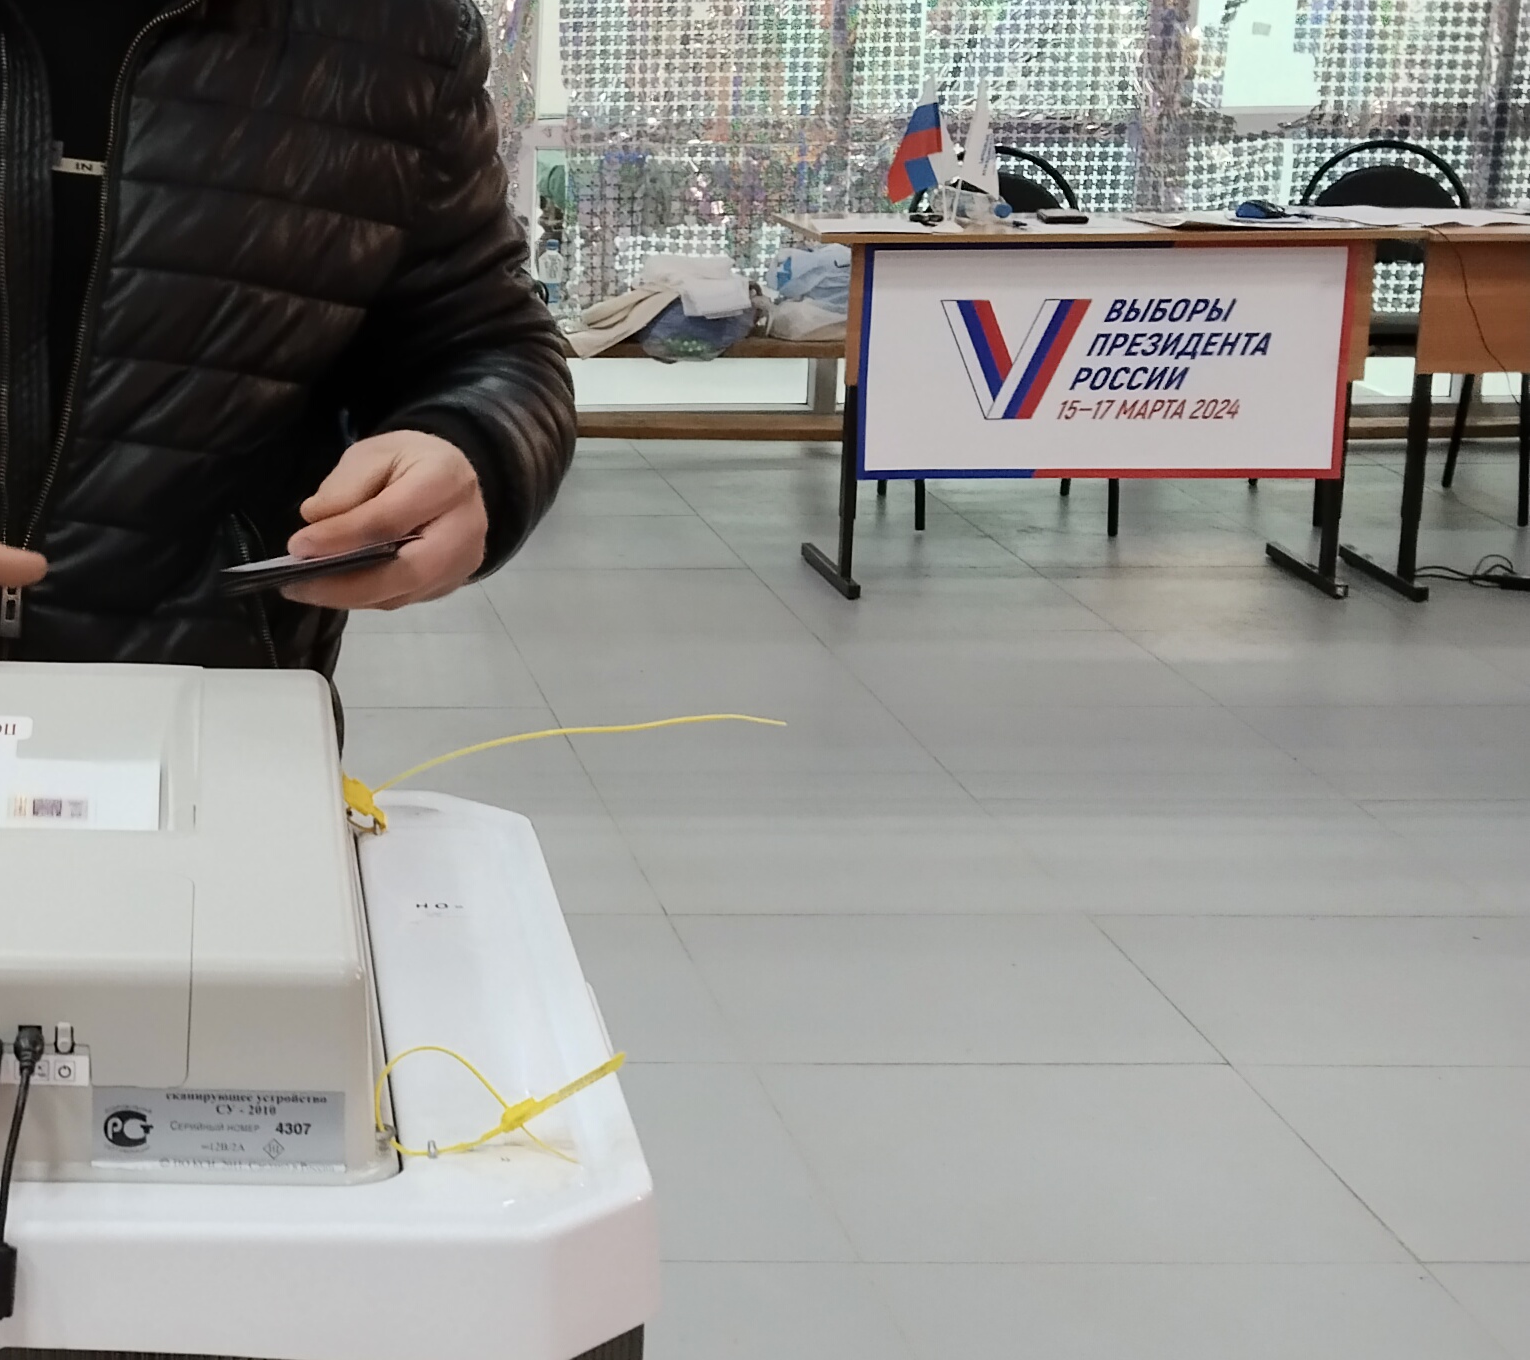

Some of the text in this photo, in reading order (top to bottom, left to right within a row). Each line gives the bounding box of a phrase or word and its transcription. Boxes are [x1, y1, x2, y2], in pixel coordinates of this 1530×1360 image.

[1104, 298, 1238, 323] ВЫБОРЫ
[1086, 331, 1272, 360] ПРЕЗИДЕНТА
[1068, 366, 1191, 391] РОССИИ
[1115, 399, 1187, 420] МАРТА
[1189, 398, 1240, 420] 2024
[166, 1092, 328, 1106] сканирующее устройство
[216, 1105, 233, 1116] СУ
[248, 1105, 277, 1117] 2010
[275, 1122, 312, 1136] 4307
